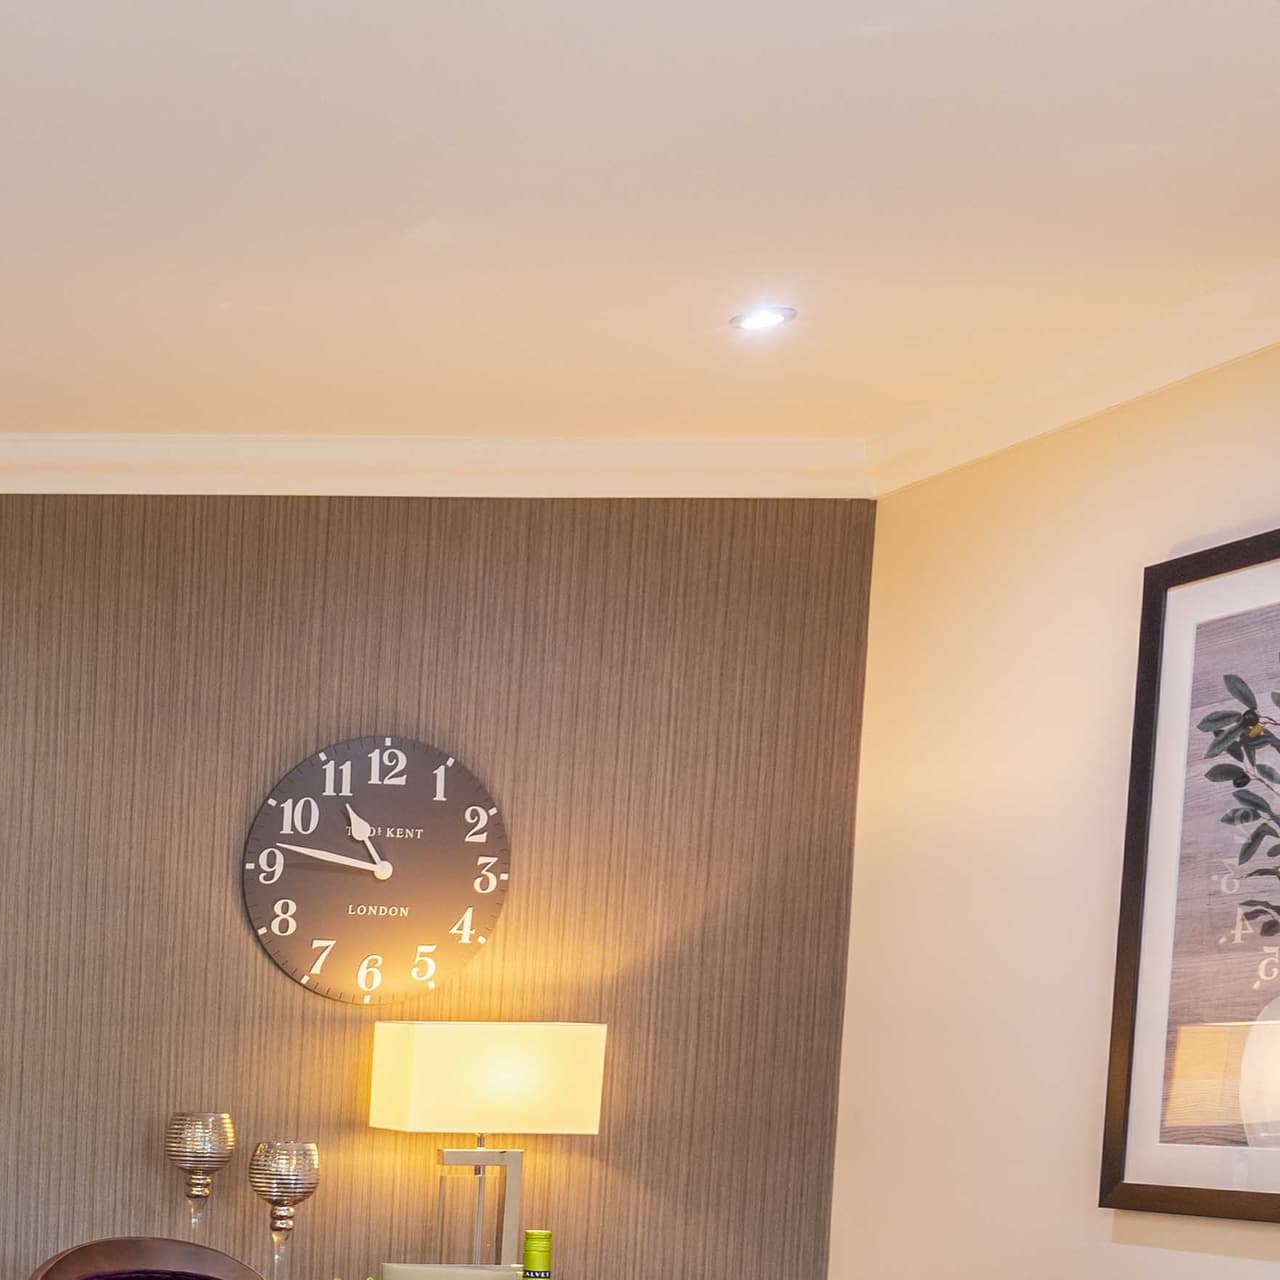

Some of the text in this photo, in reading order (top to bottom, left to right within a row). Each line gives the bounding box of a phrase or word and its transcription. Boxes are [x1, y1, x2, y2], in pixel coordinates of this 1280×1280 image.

[322, 760, 353, 796] 11
[367, 748, 408, 785] 12
[432, 764, 448, 801] 1
[279, 797, 320, 834] 10
[386, 827, 424, 840] KENT
[464, 805, 489, 843] 2
[258, 847, 285, 884] 9
[473, 856, 498, 894] 3
[270, 899, 297, 936] 8
[347, 904, 409, 917] LONDON
[449, 907, 476, 944] 4
[310, 939, 337, 975] 7
[357, 954, 383, 992] 6
[410, 944, 437, 982] 5
